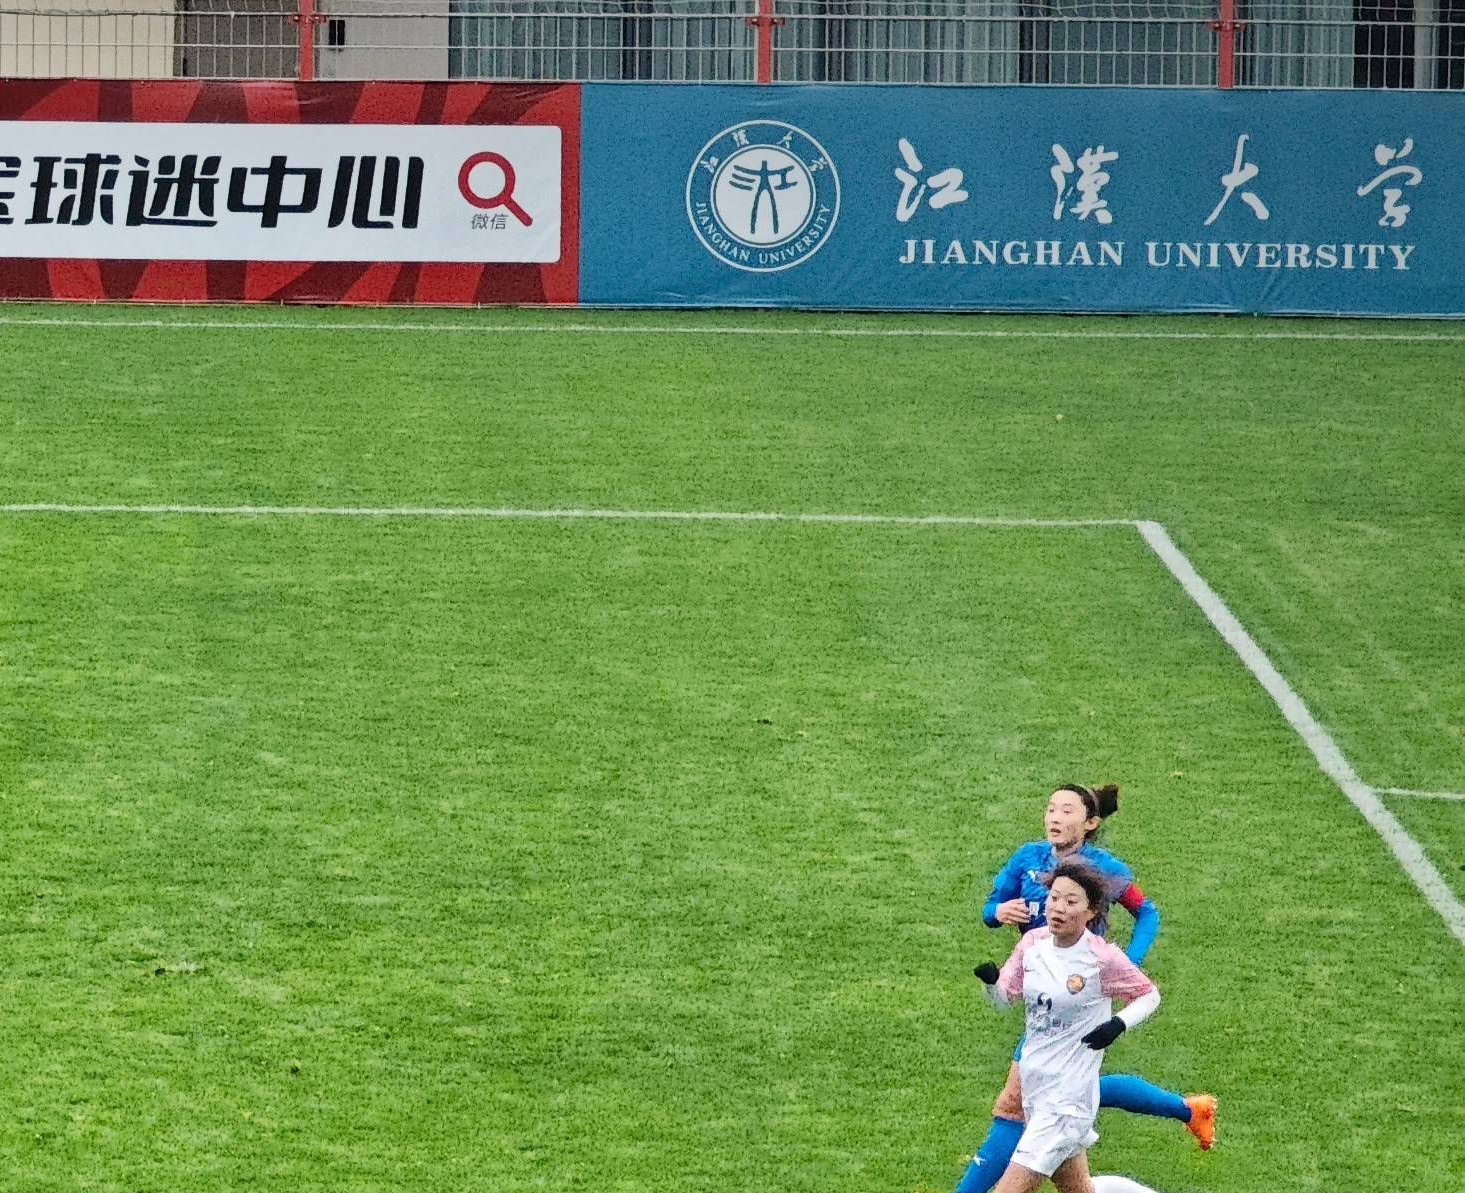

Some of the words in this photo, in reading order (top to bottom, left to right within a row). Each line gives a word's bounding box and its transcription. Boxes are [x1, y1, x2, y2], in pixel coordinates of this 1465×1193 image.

[471, 213, 509, 230] 微信
[695, 200, 751, 262] JIANGHAN
[758, 204, 831, 265] UNIVERSITY
[898, 238, 1126, 267] JIANGHAN
[1146, 241, 1417, 270] UNIVERSITY
